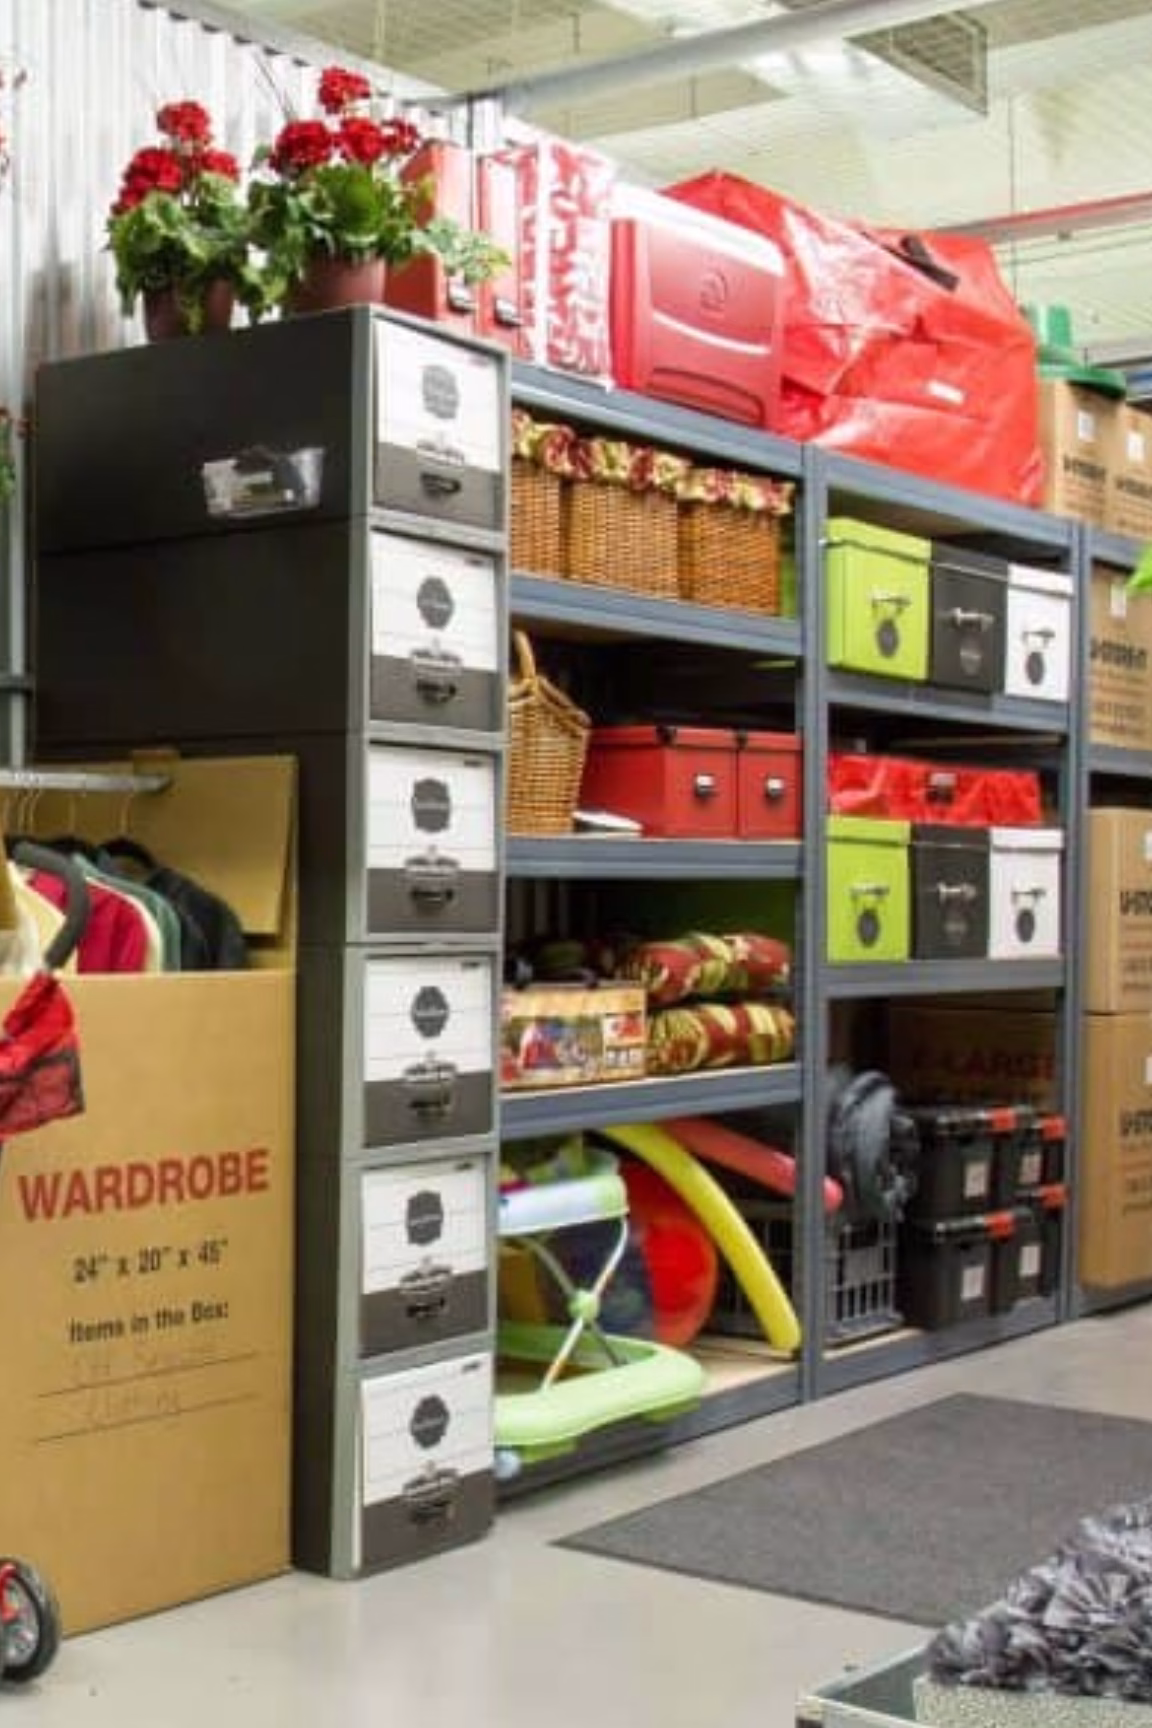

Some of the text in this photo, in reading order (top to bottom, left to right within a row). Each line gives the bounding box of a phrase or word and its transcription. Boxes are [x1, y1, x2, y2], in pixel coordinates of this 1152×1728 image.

[17, 1148, 270, 1222] WARDROBE
[69, 1301, 229, 1342] Items in the Box:
